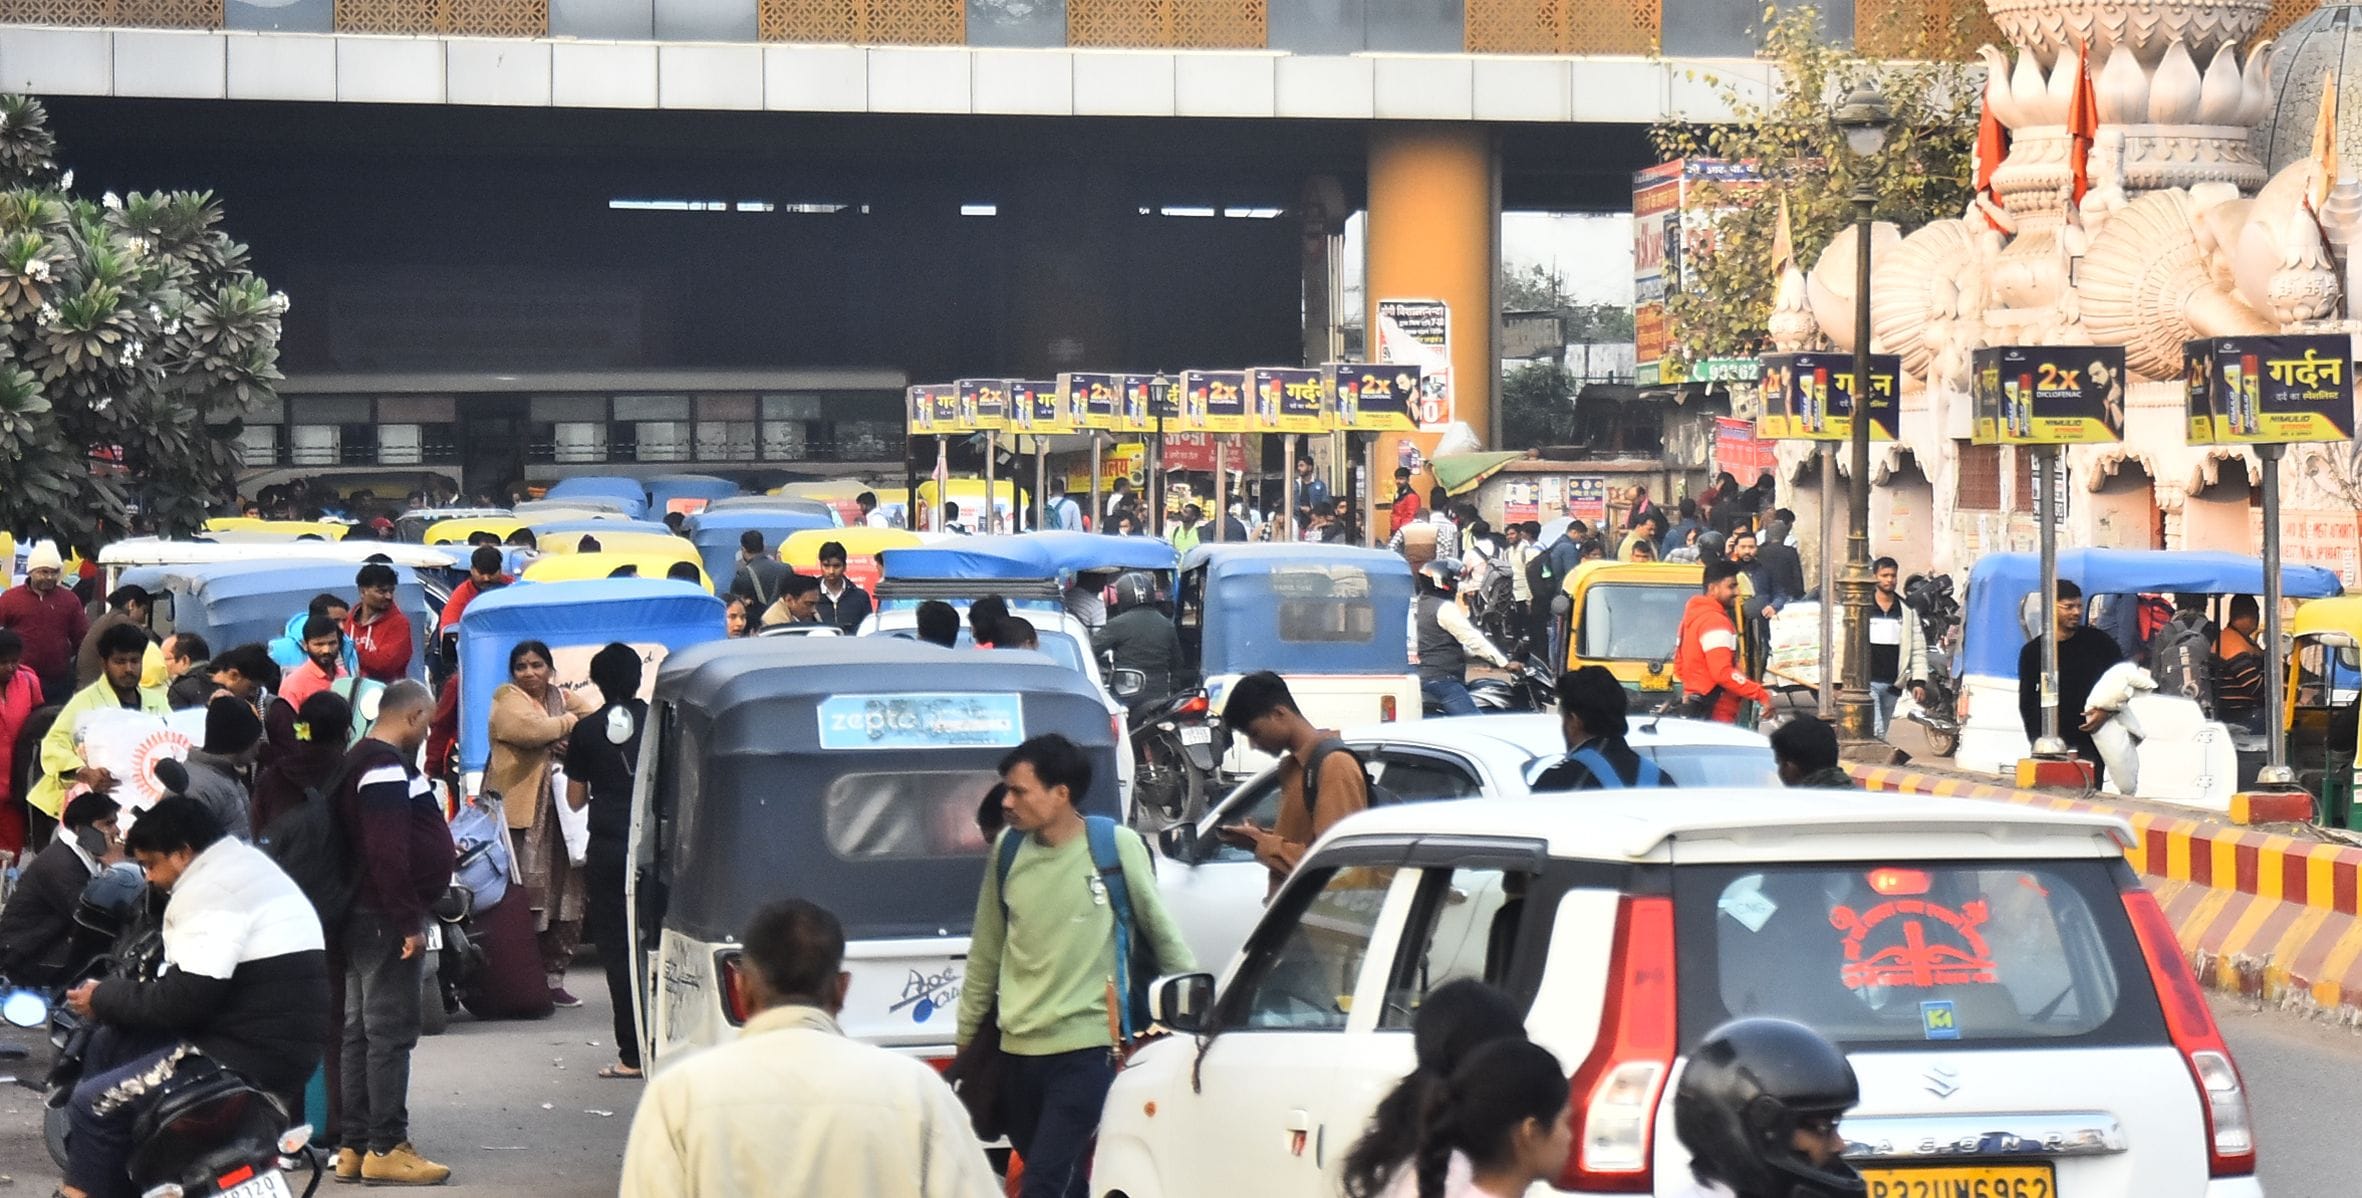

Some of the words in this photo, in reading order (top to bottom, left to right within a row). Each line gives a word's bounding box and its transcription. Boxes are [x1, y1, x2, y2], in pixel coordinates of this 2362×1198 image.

[2037, 362, 2081, 391] 2x
[2265, 348, 2343, 389] गर्दन
[1209, 381, 1239, 400] 2x
[1284, 377, 1320, 403] गर्द
[1361, 374, 1392, 395] 2x
[2036, 391, 2082, 399] DICLOFENAC
[1872, 1178, 2048, 1198] P32UN6962
